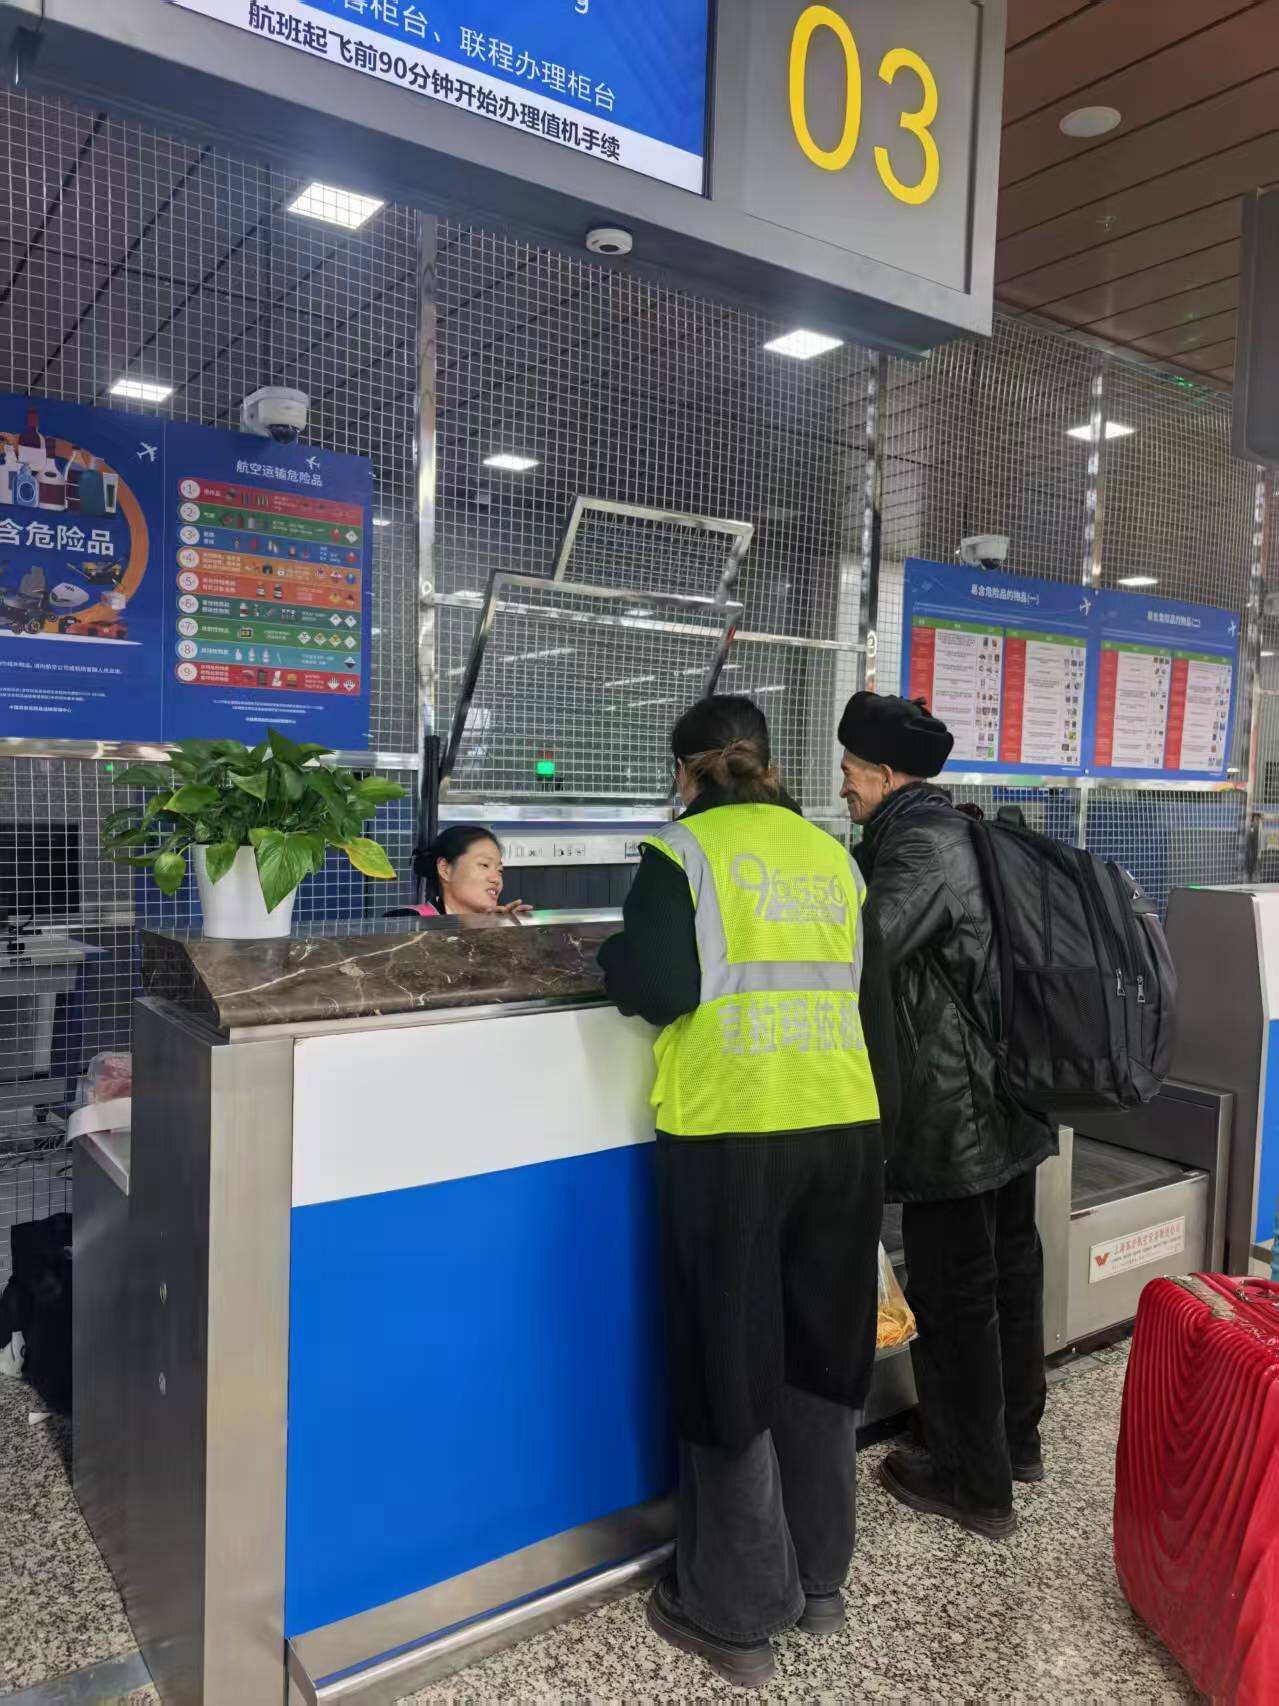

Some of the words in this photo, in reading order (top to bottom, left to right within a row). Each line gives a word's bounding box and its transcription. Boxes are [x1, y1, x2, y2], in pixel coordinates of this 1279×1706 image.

[248, 0, 621, 162] 航班起飞前90分钟开始办理值机手续
[789, 5, 940, 205] 03
[236, 459, 323, 488] 航空运输危险品
[0, 518, 114, 556] 含危险品
